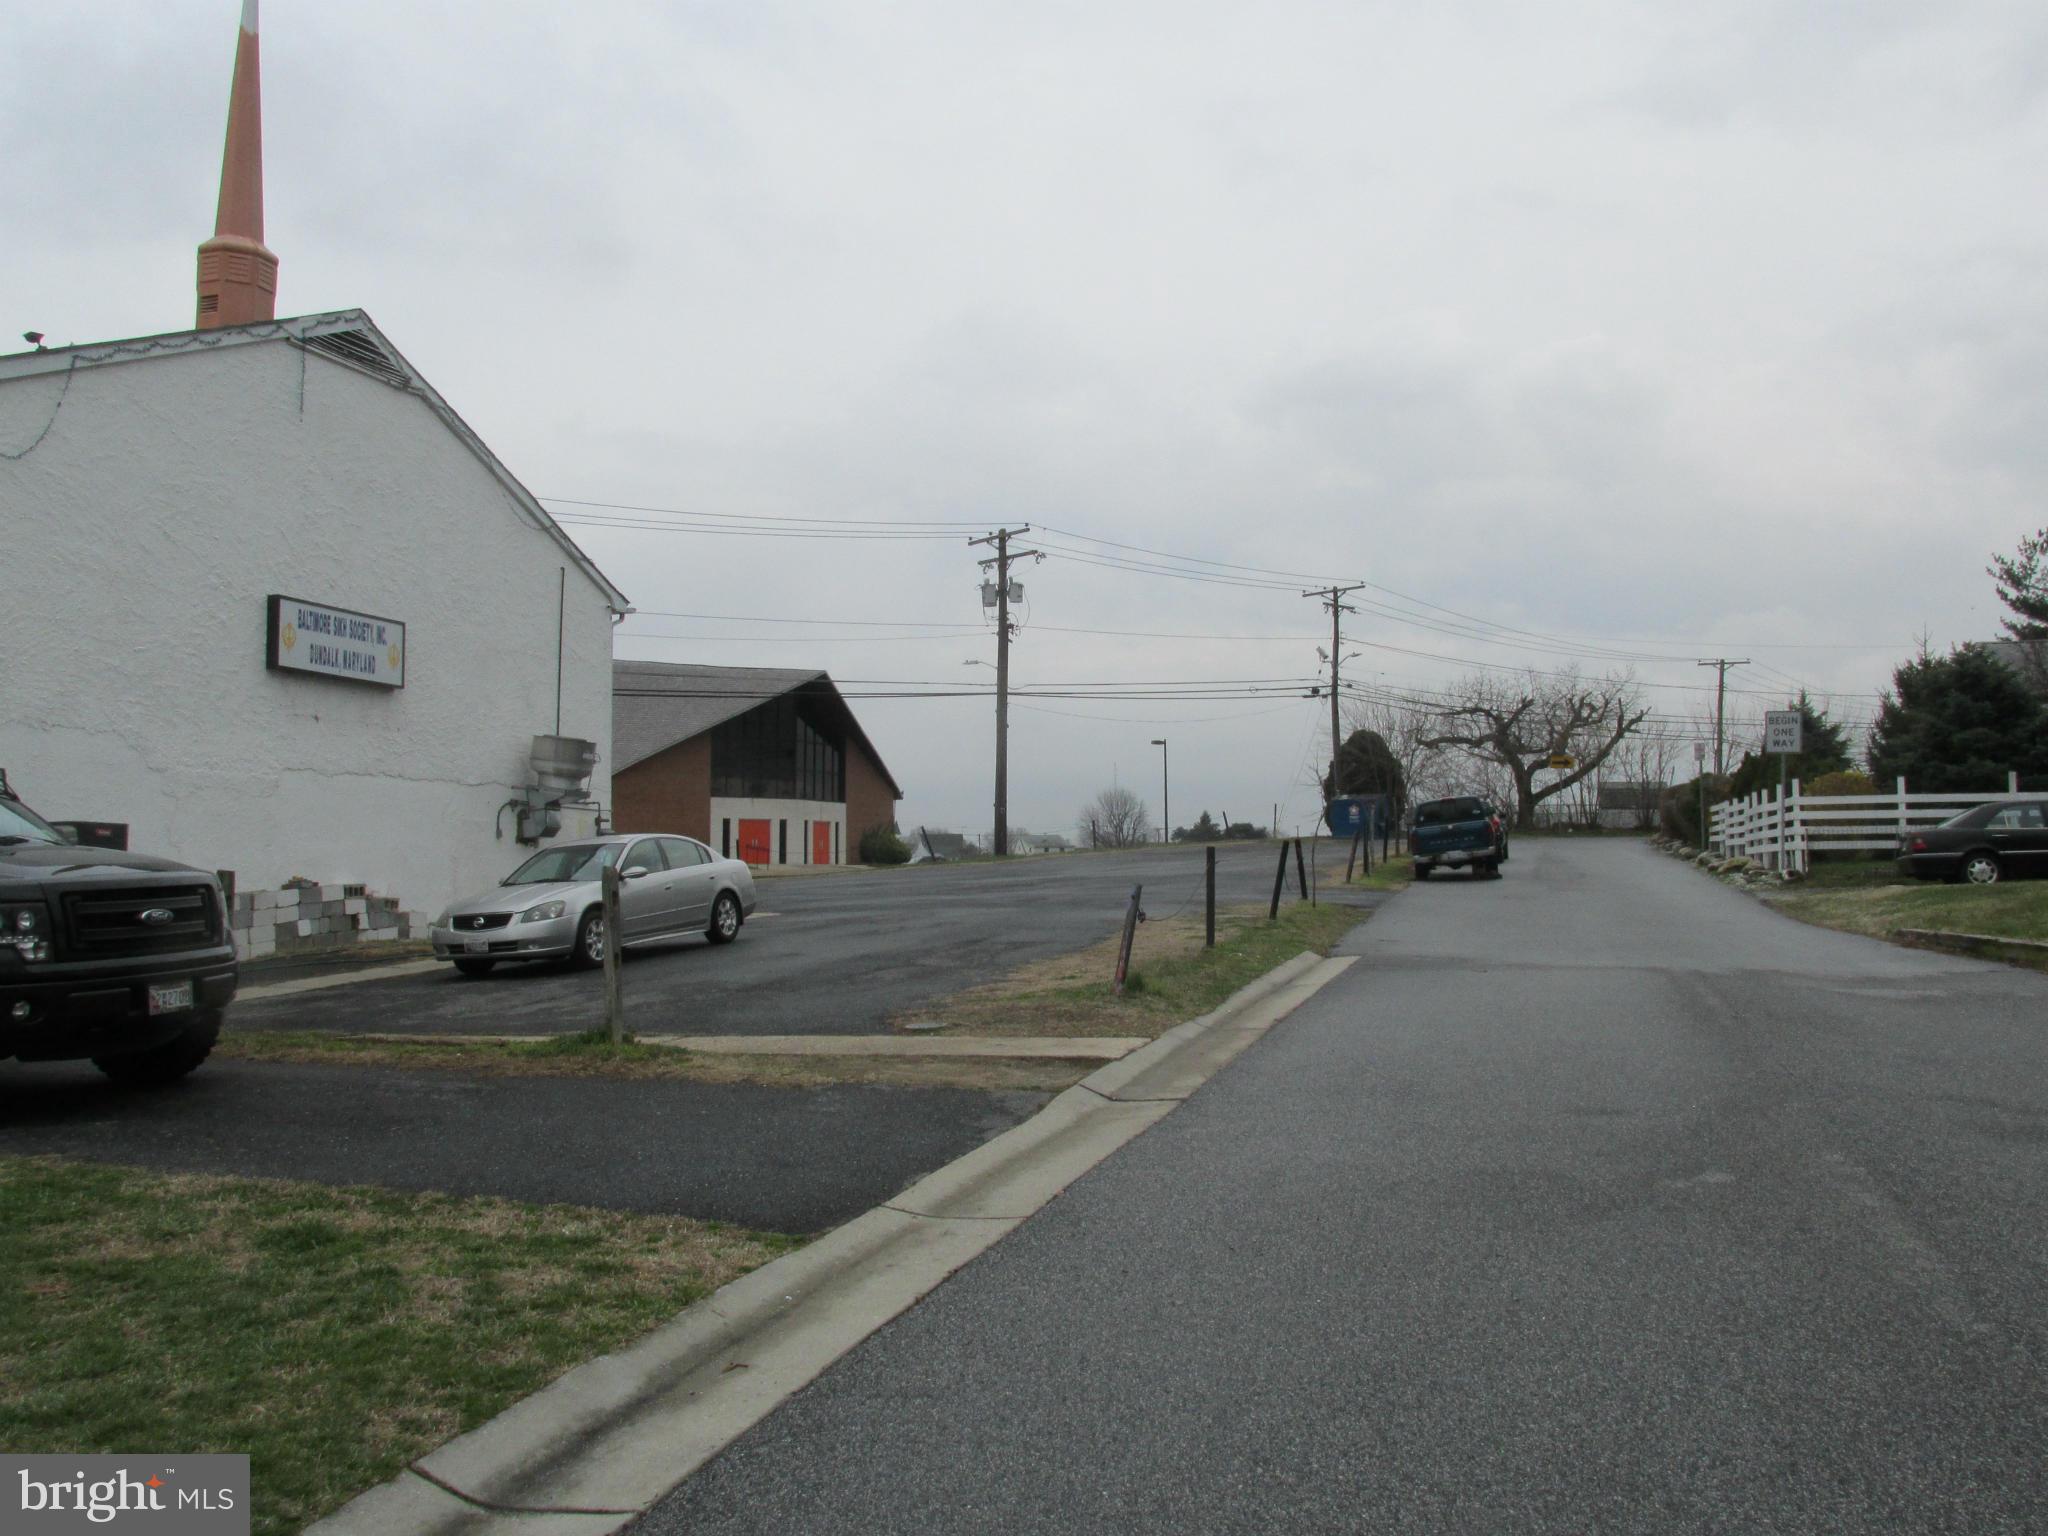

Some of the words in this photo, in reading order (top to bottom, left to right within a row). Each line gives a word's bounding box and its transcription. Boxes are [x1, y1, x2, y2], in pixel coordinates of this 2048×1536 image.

[297, 609, 331, 635] BALTIMORE
[333, 615, 348, 639] SIKH
[343, 649, 376, 674] MARYLAND
[1768, 716, 1798, 725] BEGIN
[1773, 727, 1794, 736] ONE
[1772, 739, 1795, 748] WAY
